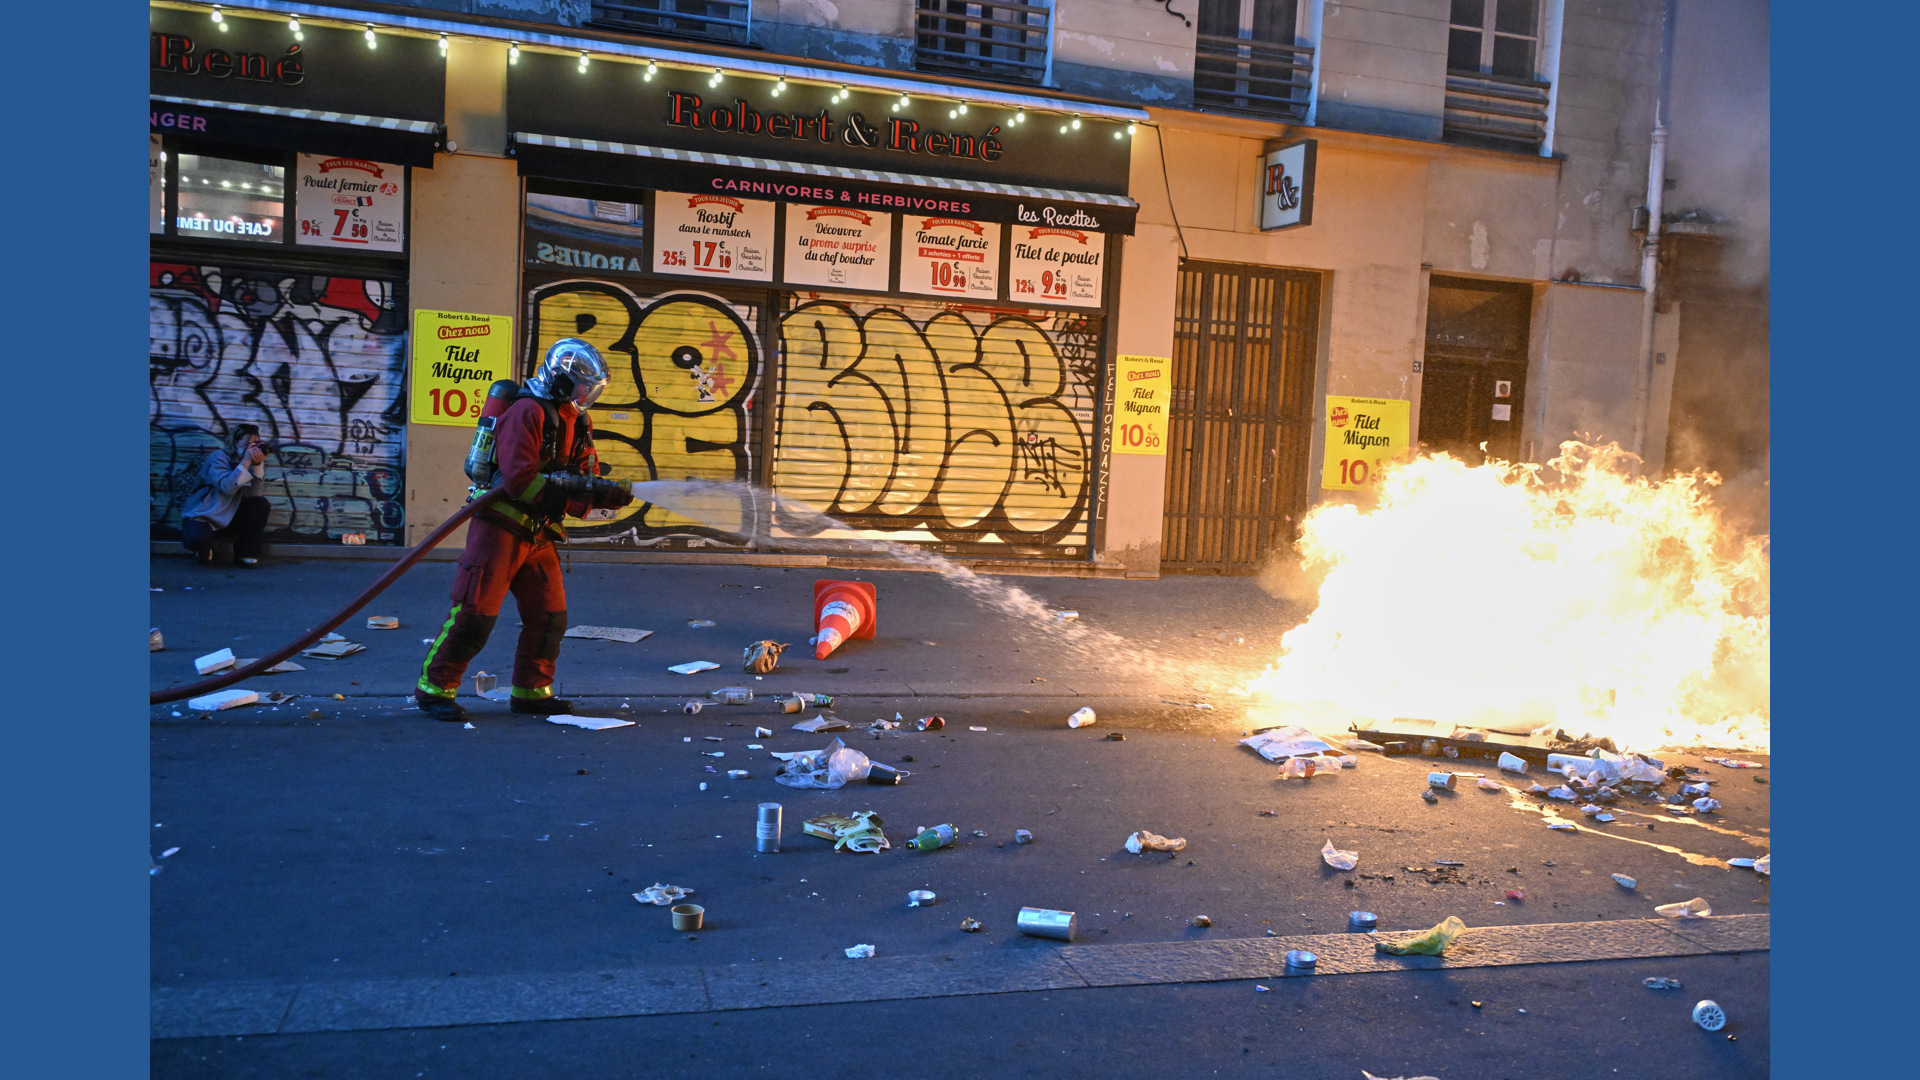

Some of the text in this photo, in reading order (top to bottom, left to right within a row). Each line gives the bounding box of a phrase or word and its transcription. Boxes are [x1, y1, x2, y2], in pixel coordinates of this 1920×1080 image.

[152, 32, 305, 86] René
[666, 90, 1003, 163] Robert & René
[354, 161, 378, 172] MARDIS
[304, 175, 378, 193] Poulet fermier
[712, 178, 970, 214] CARNIVORES & HERBIVORES
[720, 197, 738, 206] JEUDIS
[696, 209, 737, 228] Rosbif
[838, 209, 865, 219] VENDREDIS
[1018, 204, 1100, 228] les Recettes
[333, 208, 359, 236] 7 €
[954, 220, 974, 228] SAMEDIS
[352, 224, 368, 238] 50
[679, 224, 751, 238] dans le rumsteck
[816, 223, 862, 237] Découvrez
[1060, 229, 1080, 237] SAMEDIS
[799, 236, 877, 254] la promo surprise
[916, 231, 988, 250] Tomate farcie
[663, 250, 678, 265] 25
[693, 240, 725, 266] 17 €
[805, 250, 875, 265] du chef boucher
[1015, 244, 1100, 266] Filet de poulet
[719, 255, 731, 268] 10
[931, 262, 951, 286] 10
[953, 275, 966, 287] 90
[1042, 270, 1053, 293] 9
[1015, 279, 1027, 293] 12
[1055, 283, 1067, 295] 90
[438, 312, 463, 321] Robert
[439, 325, 489, 337] Chez nous
[445, 345, 480, 362] Filet
[432, 362, 492, 384] Mignon
[1128, 372, 1144, 380] Chez
[1133, 388, 1154, 399] Filet
[429, 388, 481, 417] 10 €
[1124, 401, 1160, 416] Mignon
[1332, 408, 1348, 417] Chez
[1354, 414, 1380, 430] Filet
[1121, 424, 1143, 446] 10
[1145, 437, 1160, 447] 90
[1344, 430, 1390, 450] Mignon
[1340, 459, 1368, 485] 10
